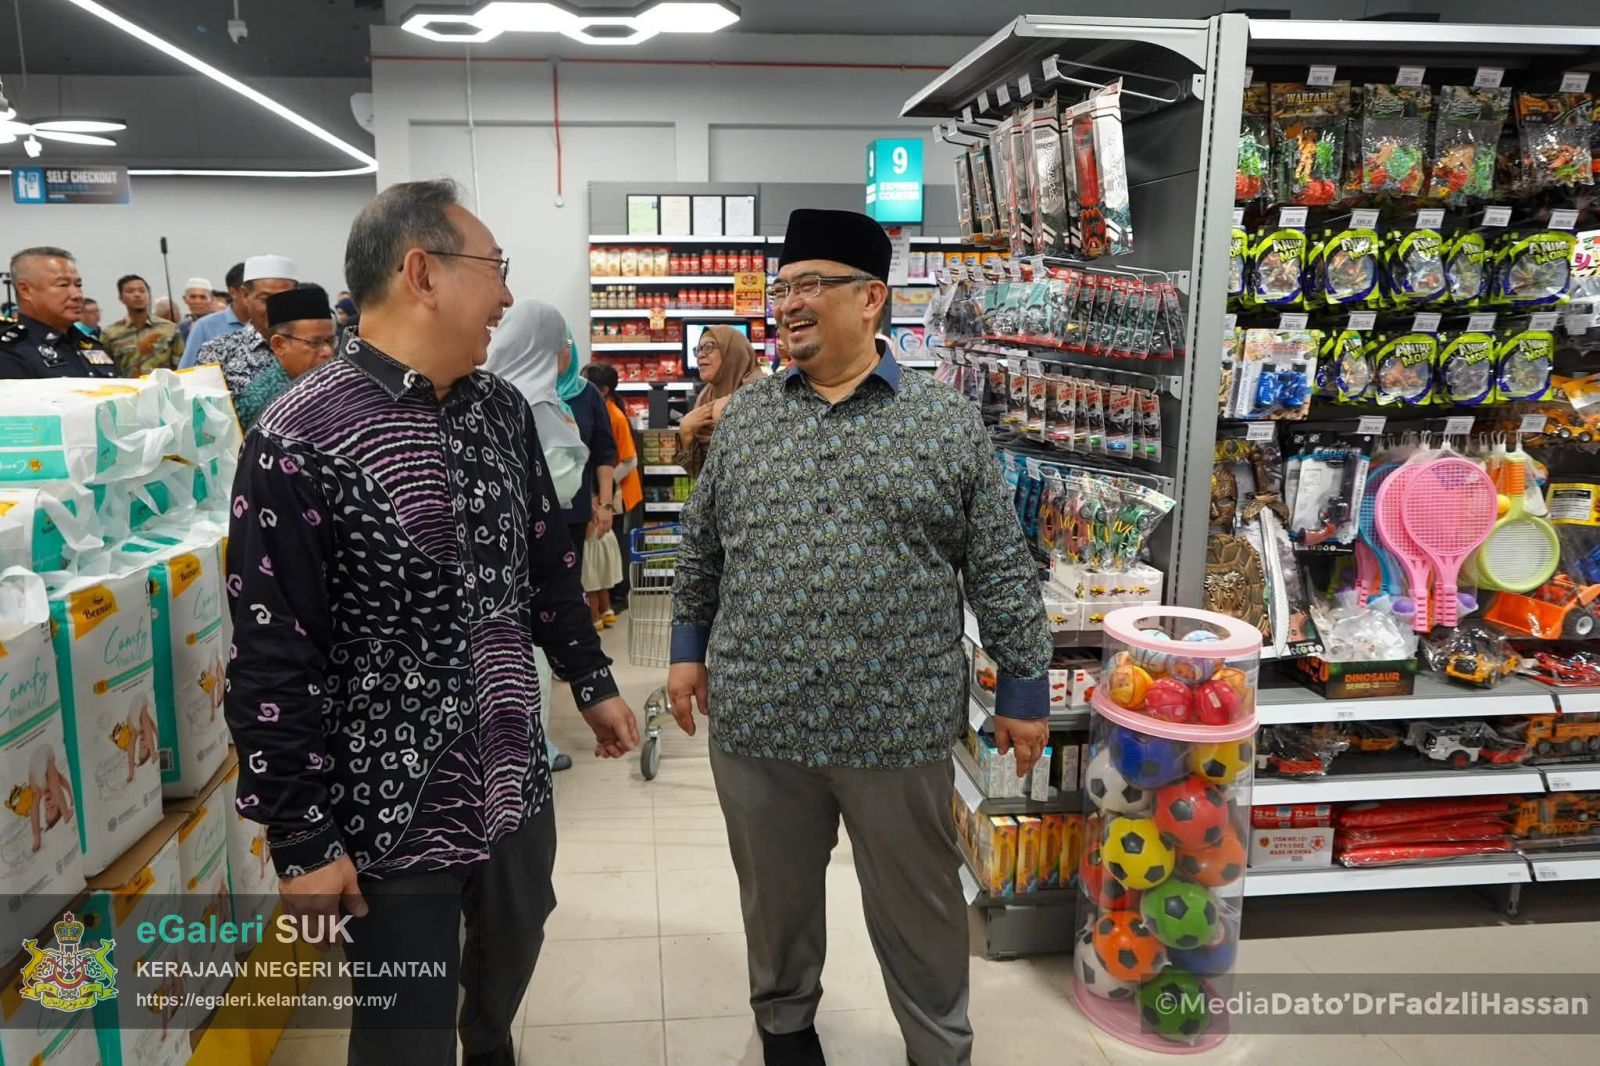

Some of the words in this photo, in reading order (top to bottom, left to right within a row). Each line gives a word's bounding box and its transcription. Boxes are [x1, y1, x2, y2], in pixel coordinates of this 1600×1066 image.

[1287, 92, 1334, 103] WARFARE
[868, 150, 875, 178] 9
[892, 146, 908, 175] 9
[46, 170, 69, 183] SELF
[70, 171, 118, 184] CHECKOUT
[1344, 672, 1400, 683] DINOSAUR
